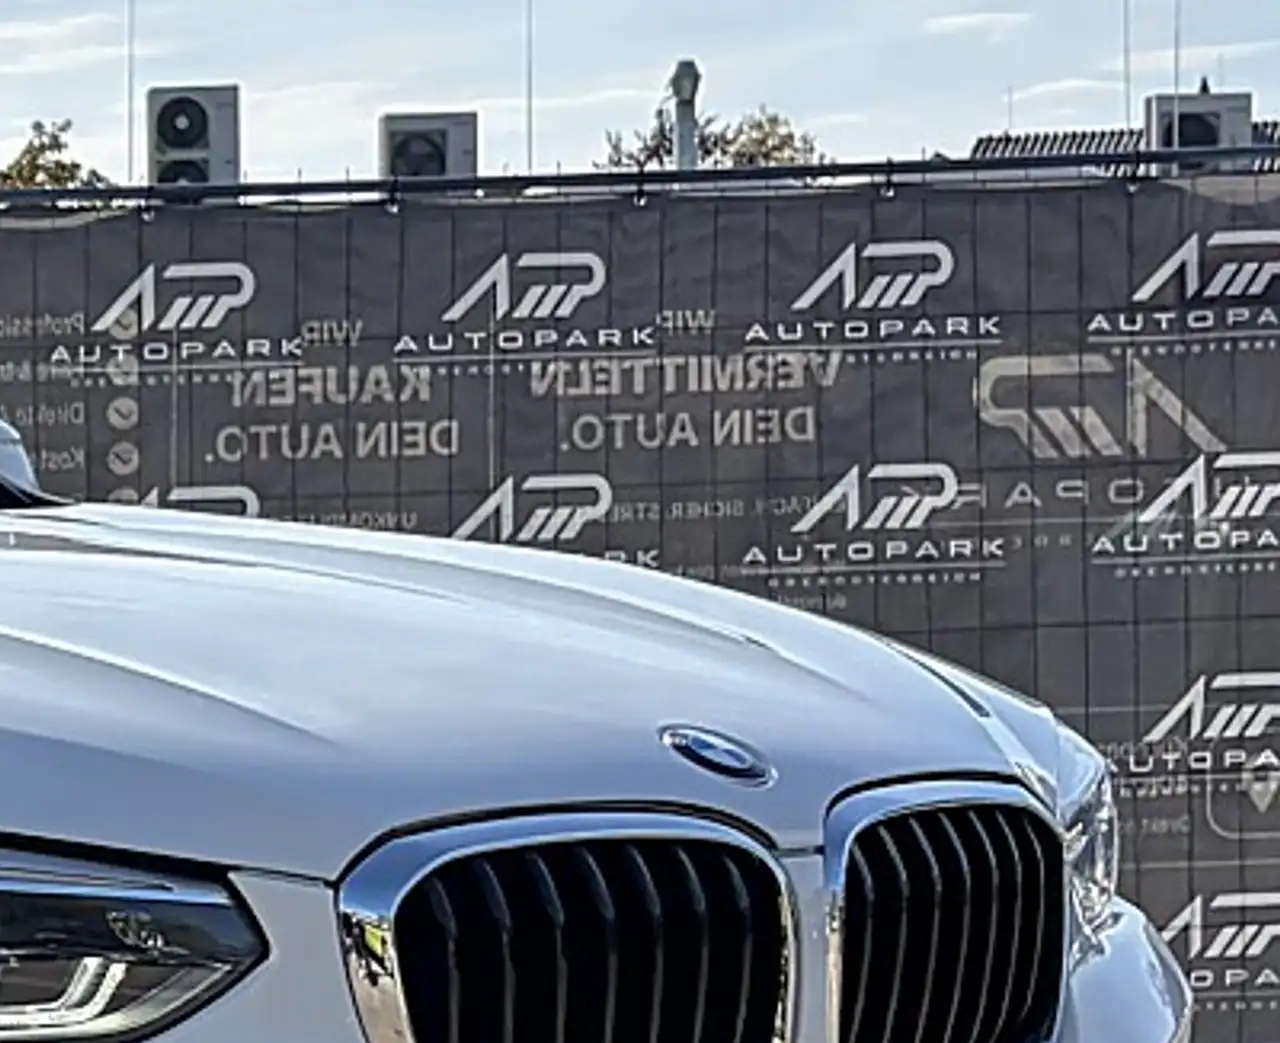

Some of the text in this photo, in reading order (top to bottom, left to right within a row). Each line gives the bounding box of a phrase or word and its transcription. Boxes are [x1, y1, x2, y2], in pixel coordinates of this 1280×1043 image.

[393, 325, 657, 352] AUTOPARK
[745, 315, 1001, 341] AUTOPARK
[50, 336, 306, 364] AUTOPARK
[742, 537, 1004, 564] AUTOPARK
